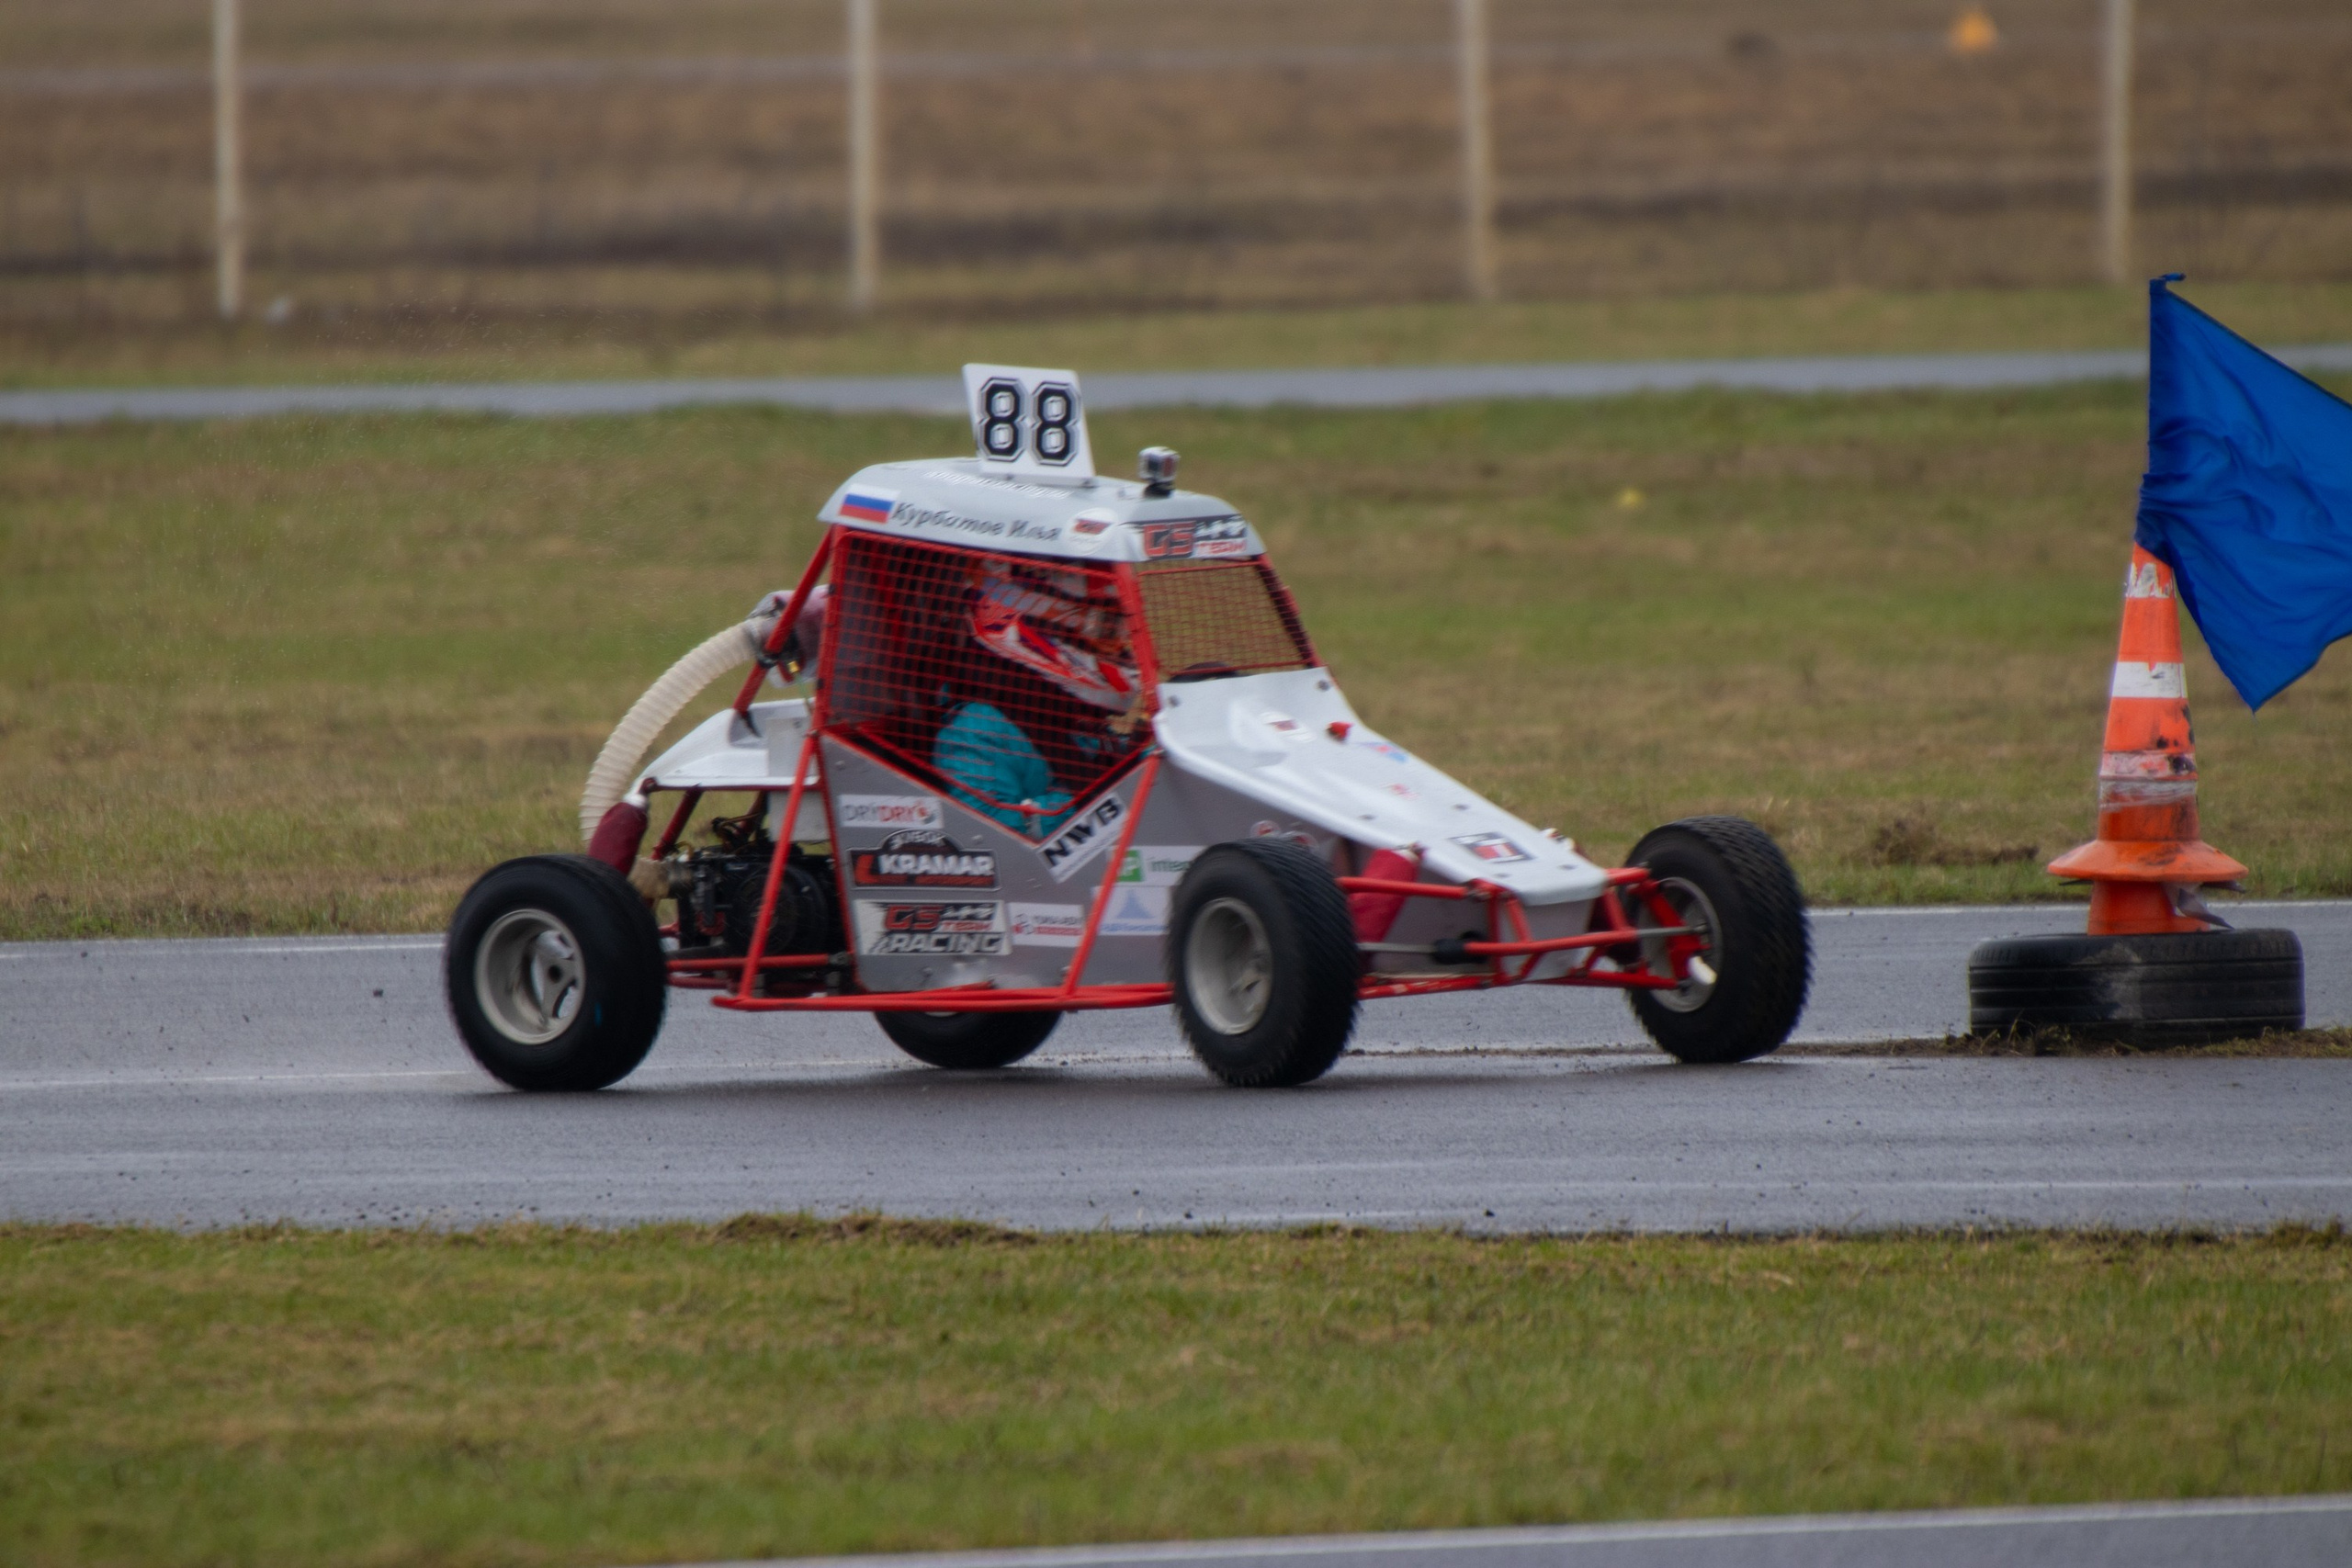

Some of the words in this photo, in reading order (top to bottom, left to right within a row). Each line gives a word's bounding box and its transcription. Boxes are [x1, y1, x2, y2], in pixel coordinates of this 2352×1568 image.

[978, 377, 1081, 467] 88
[1007, 519, 1062, 541] Илья
[1143, 520, 1196, 557] GS
[1043, 797, 1121, 867] NWB
[878, 854, 995, 876] KRAMAR
[885, 904, 945, 931] GS
[888, 933, 1003, 953] RACING
